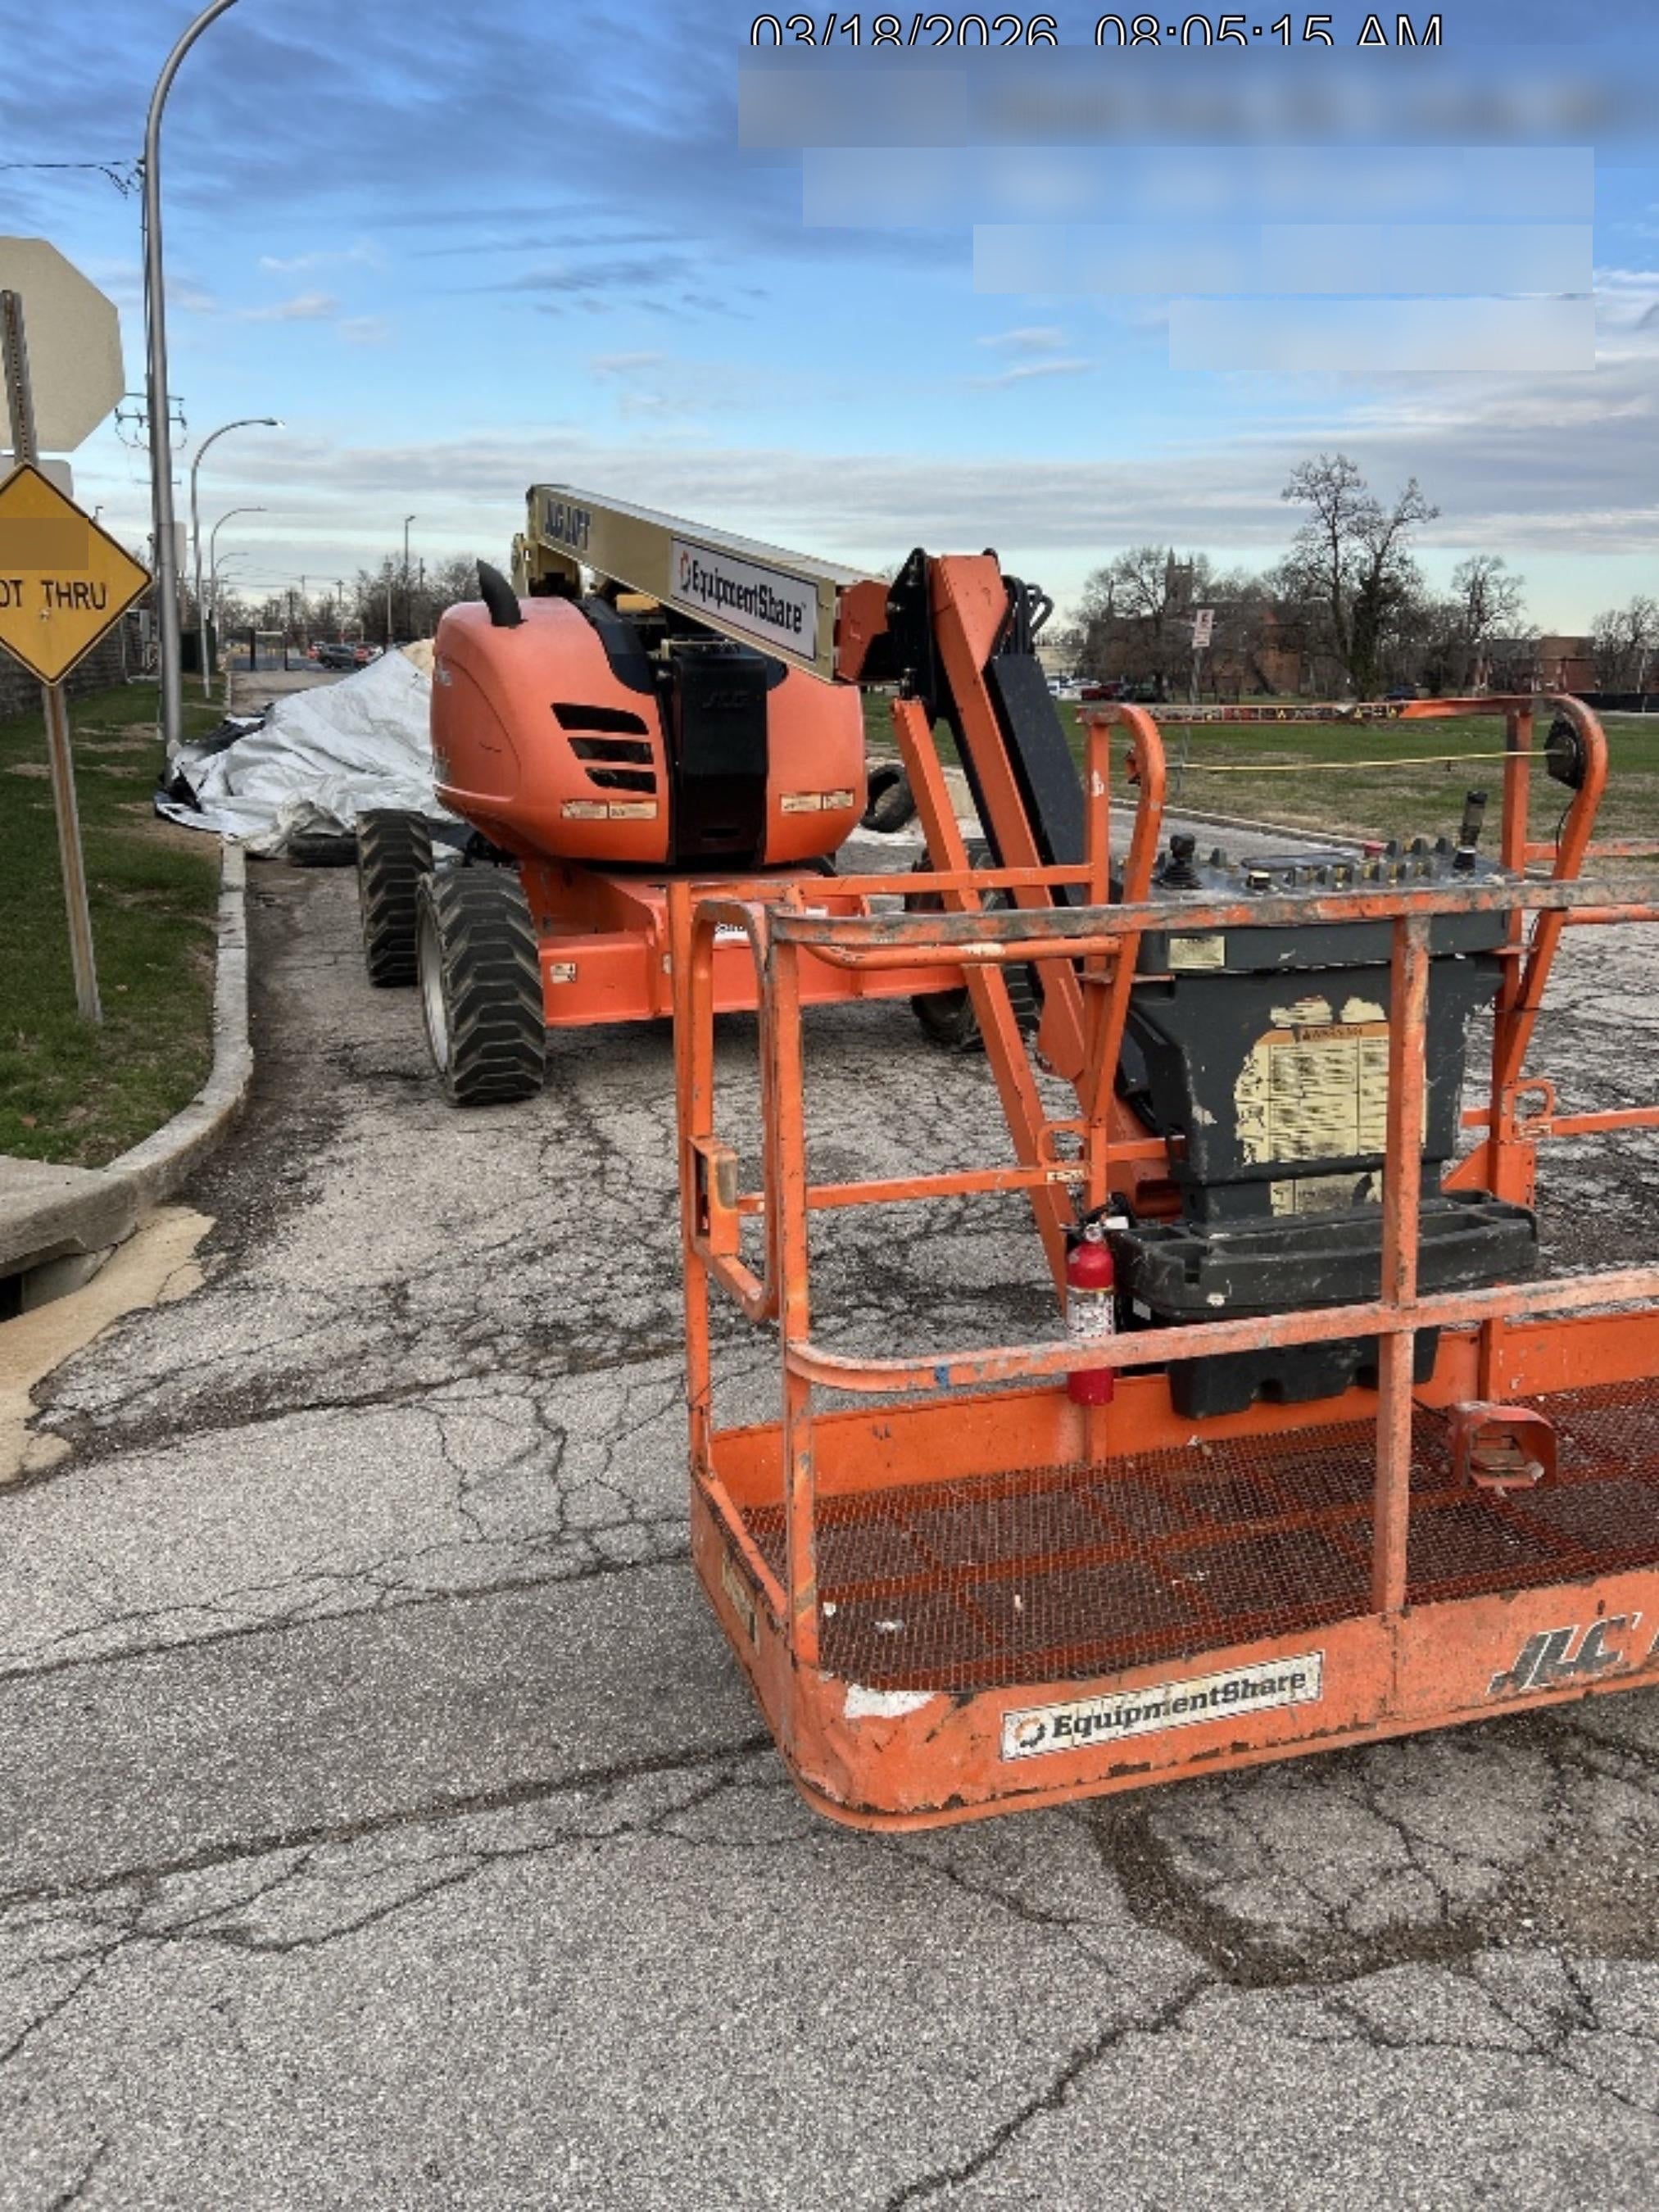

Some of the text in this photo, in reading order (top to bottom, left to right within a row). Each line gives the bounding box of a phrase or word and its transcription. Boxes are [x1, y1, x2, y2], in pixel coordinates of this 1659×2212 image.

[40, 579, 107, 610] THRU
[692, 560, 803, 634] EquipmentShare
[1052, 1670, 1307, 1738] EquipmentShare
